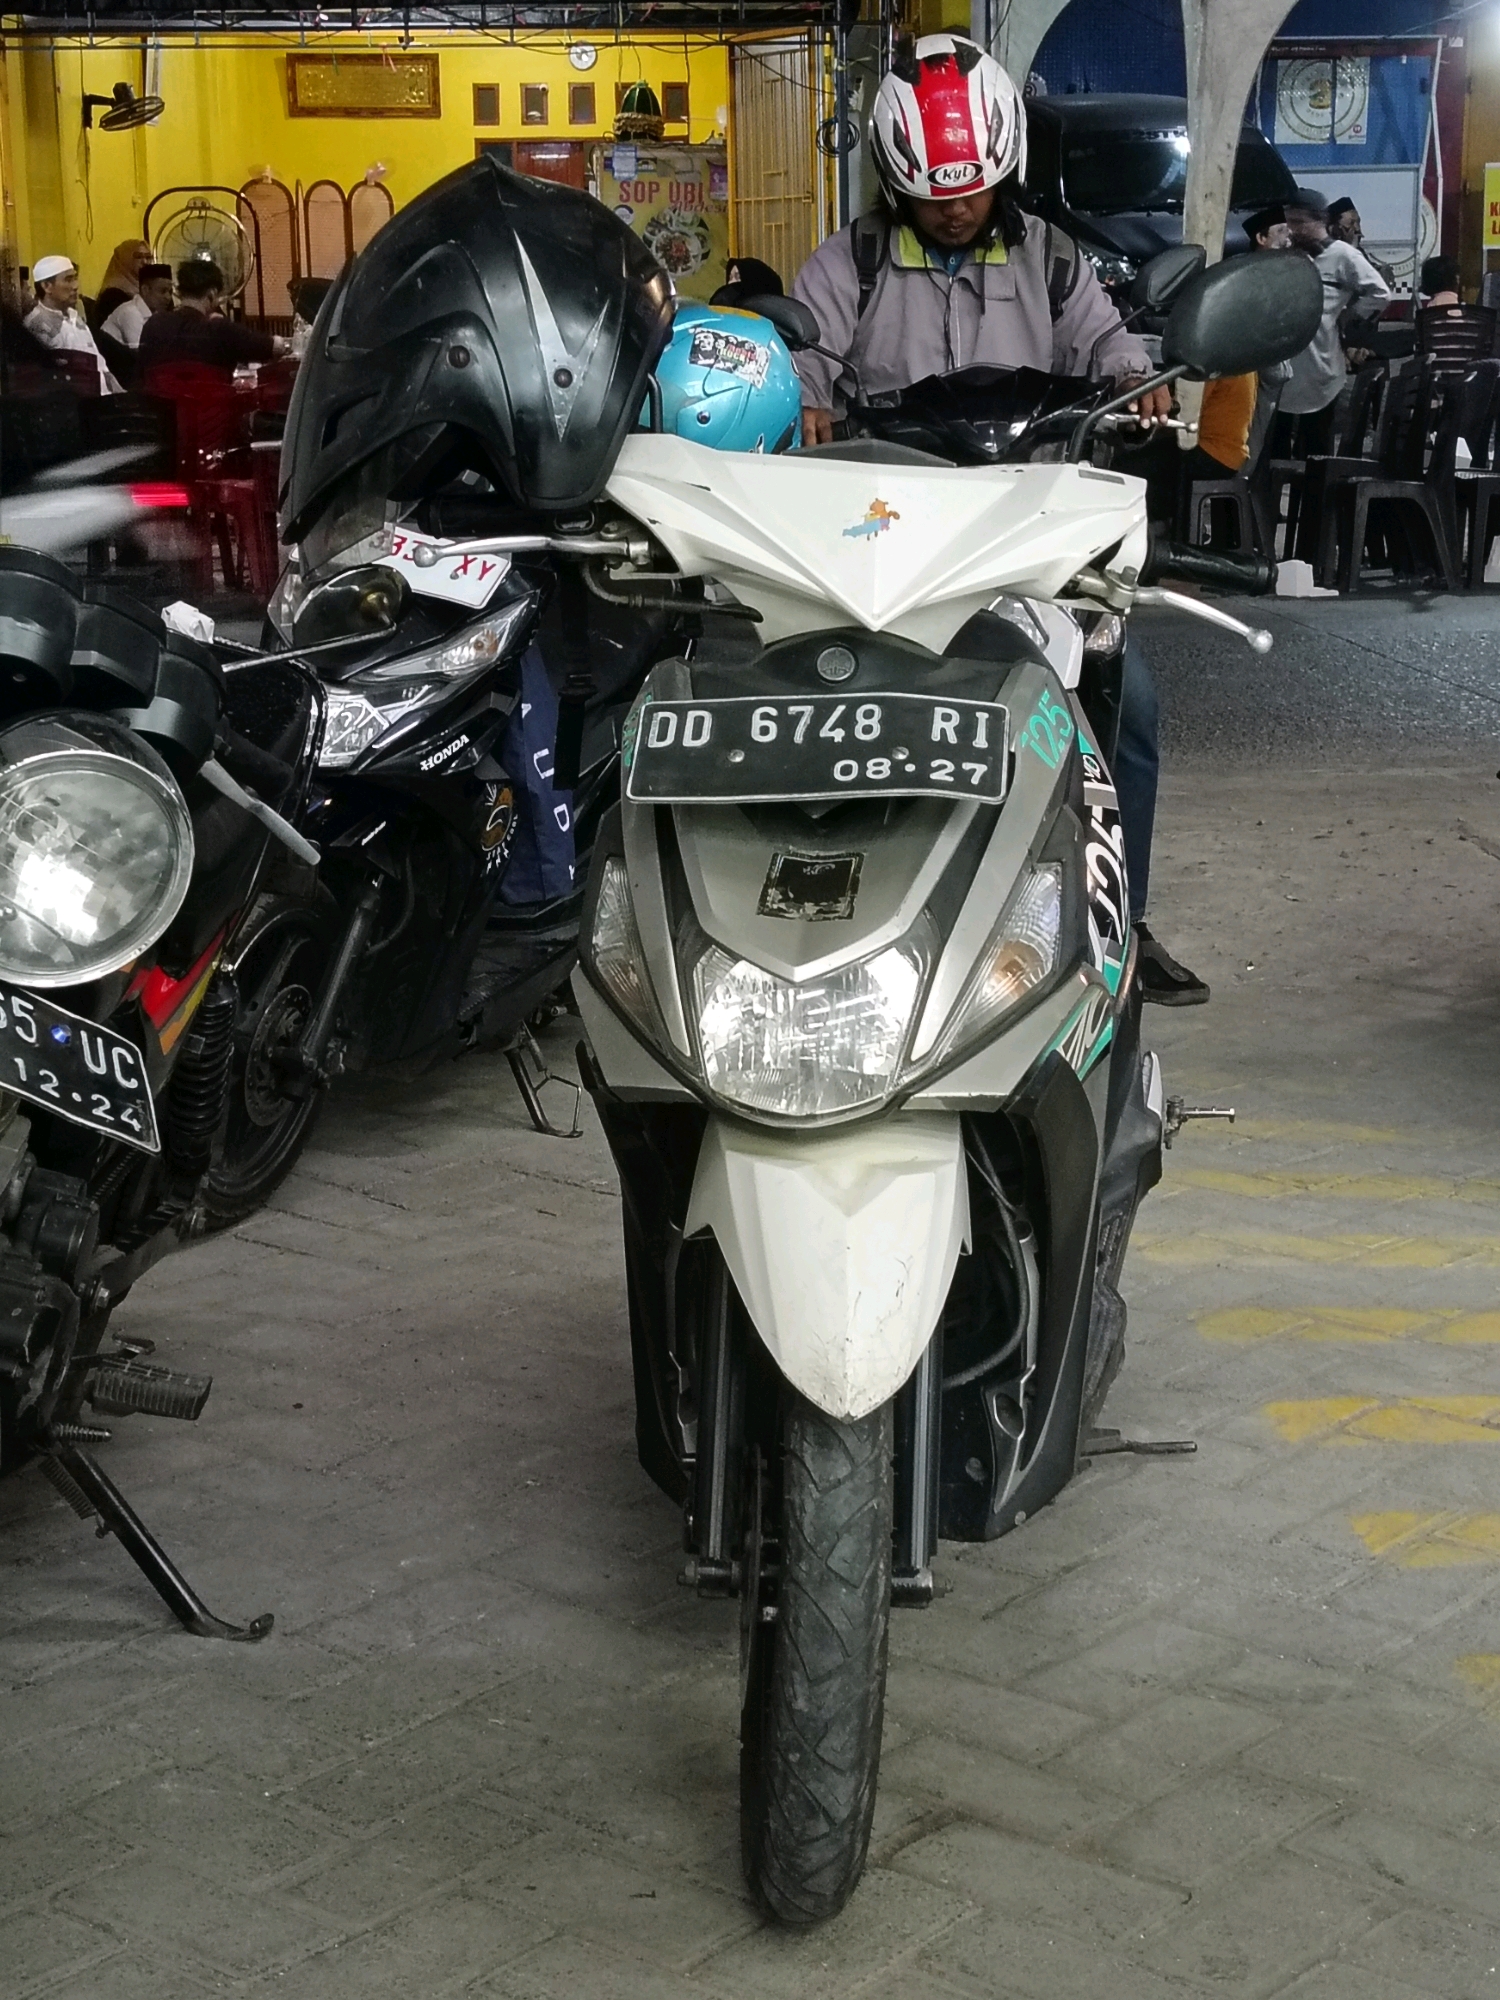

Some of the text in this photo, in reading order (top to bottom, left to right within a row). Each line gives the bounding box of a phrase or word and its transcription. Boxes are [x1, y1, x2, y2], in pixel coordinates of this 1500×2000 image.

[619, 181, 704, 204] SOP UBI
[647, 710, 713, 748] DD
[751, 703, 882, 744] 6748
[930, 706, 989, 749] RI
[419, 734, 470, 771] HONDA
[80, 1029, 139, 1089] UC
